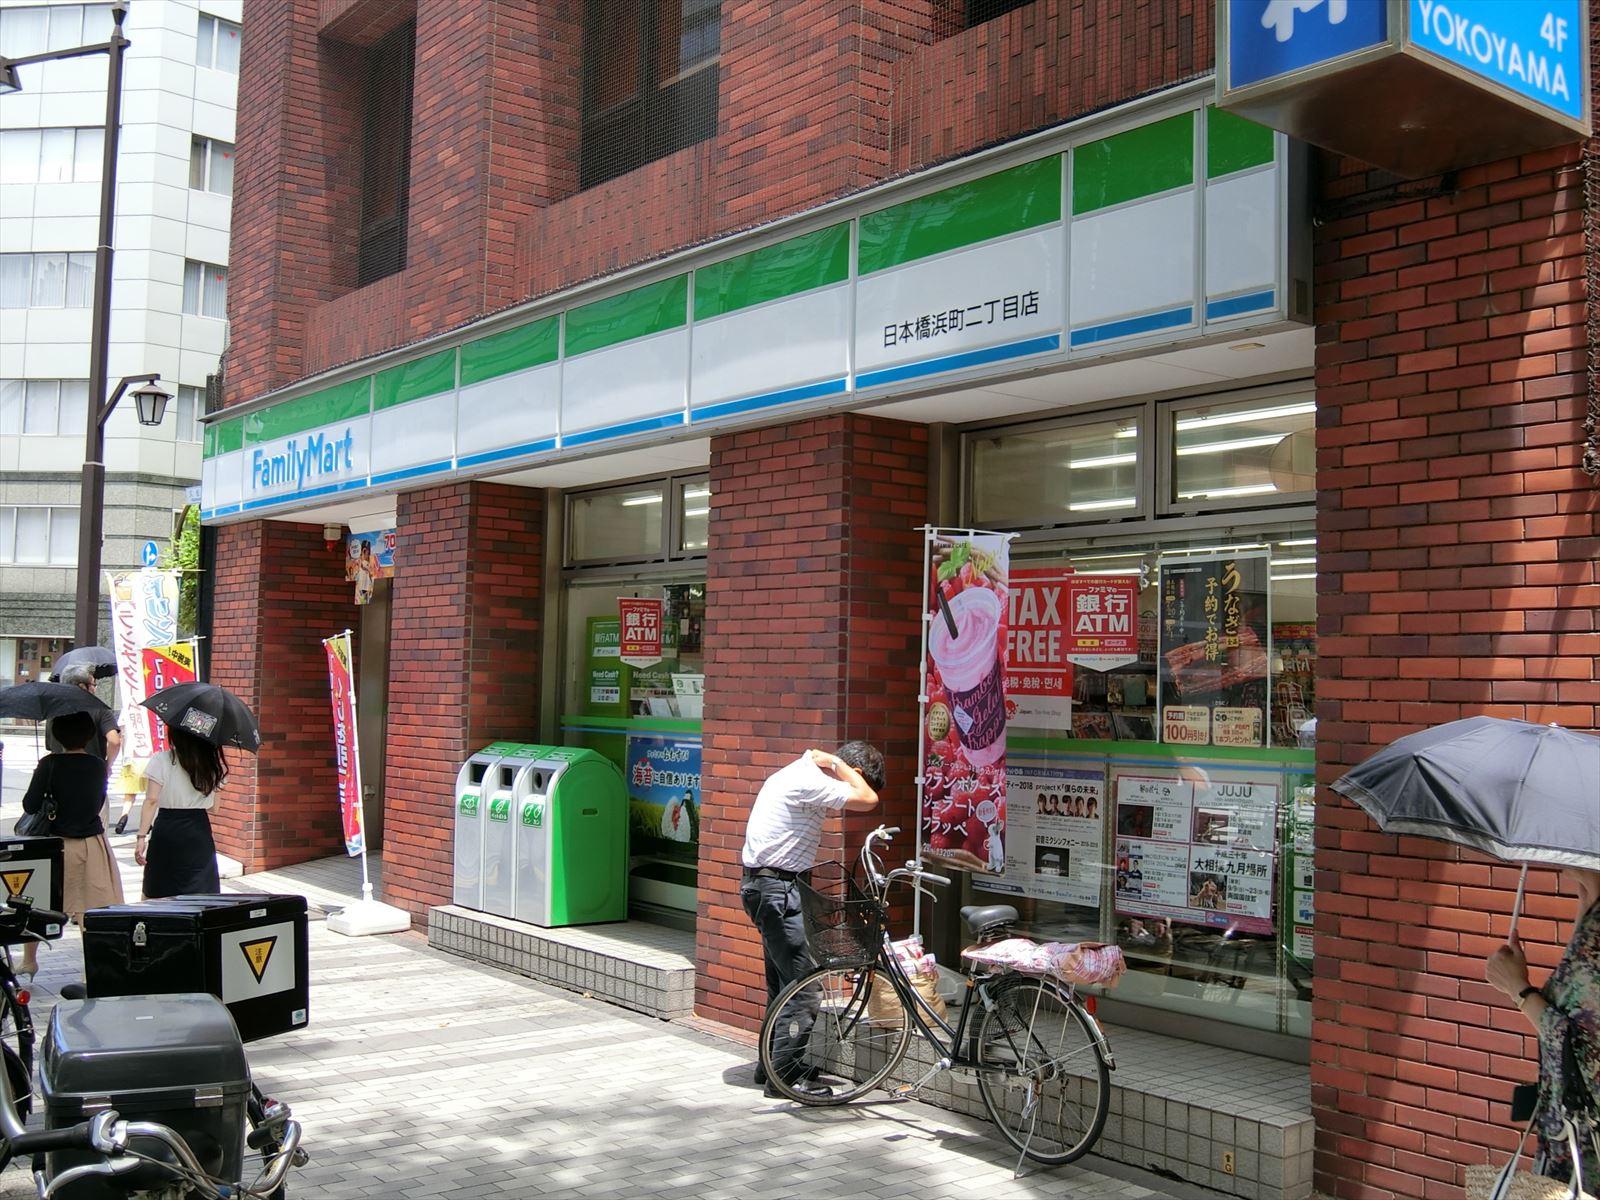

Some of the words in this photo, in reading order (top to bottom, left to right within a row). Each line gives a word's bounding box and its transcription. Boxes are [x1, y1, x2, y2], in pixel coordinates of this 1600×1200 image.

[1540, 12, 1568, 53] 4F
[1418, 0, 1570, 102] YOKOYAMA
[883, 290, 1040, 348] 日本橋浜町二丁目店
[252, 428, 354, 490] FamilyMart
[1008, 587, 1062, 626] TAX
[1076, 594, 1129, 613] 銀行
[1221, 561, 1242, 634] うなぎ
[625, 612, 657, 627] 銀行
[1075, 614, 1129, 632] ATM
[1204, 577, 1219, 662] 予約でお得
[625, 627, 657, 641] ATM
[1006, 629, 1062, 662] FREE
[1217, 785, 1252, 798] JUJU
[923, 793, 976, 817] ジェラート
[922, 816, 970, 837] フラッペ
[1215, 849, 1248, 861] 平成三十年
[1194, 857, 1268, 878] 大相撲九月場所
[1224, 1163, 1232, 1173] G
